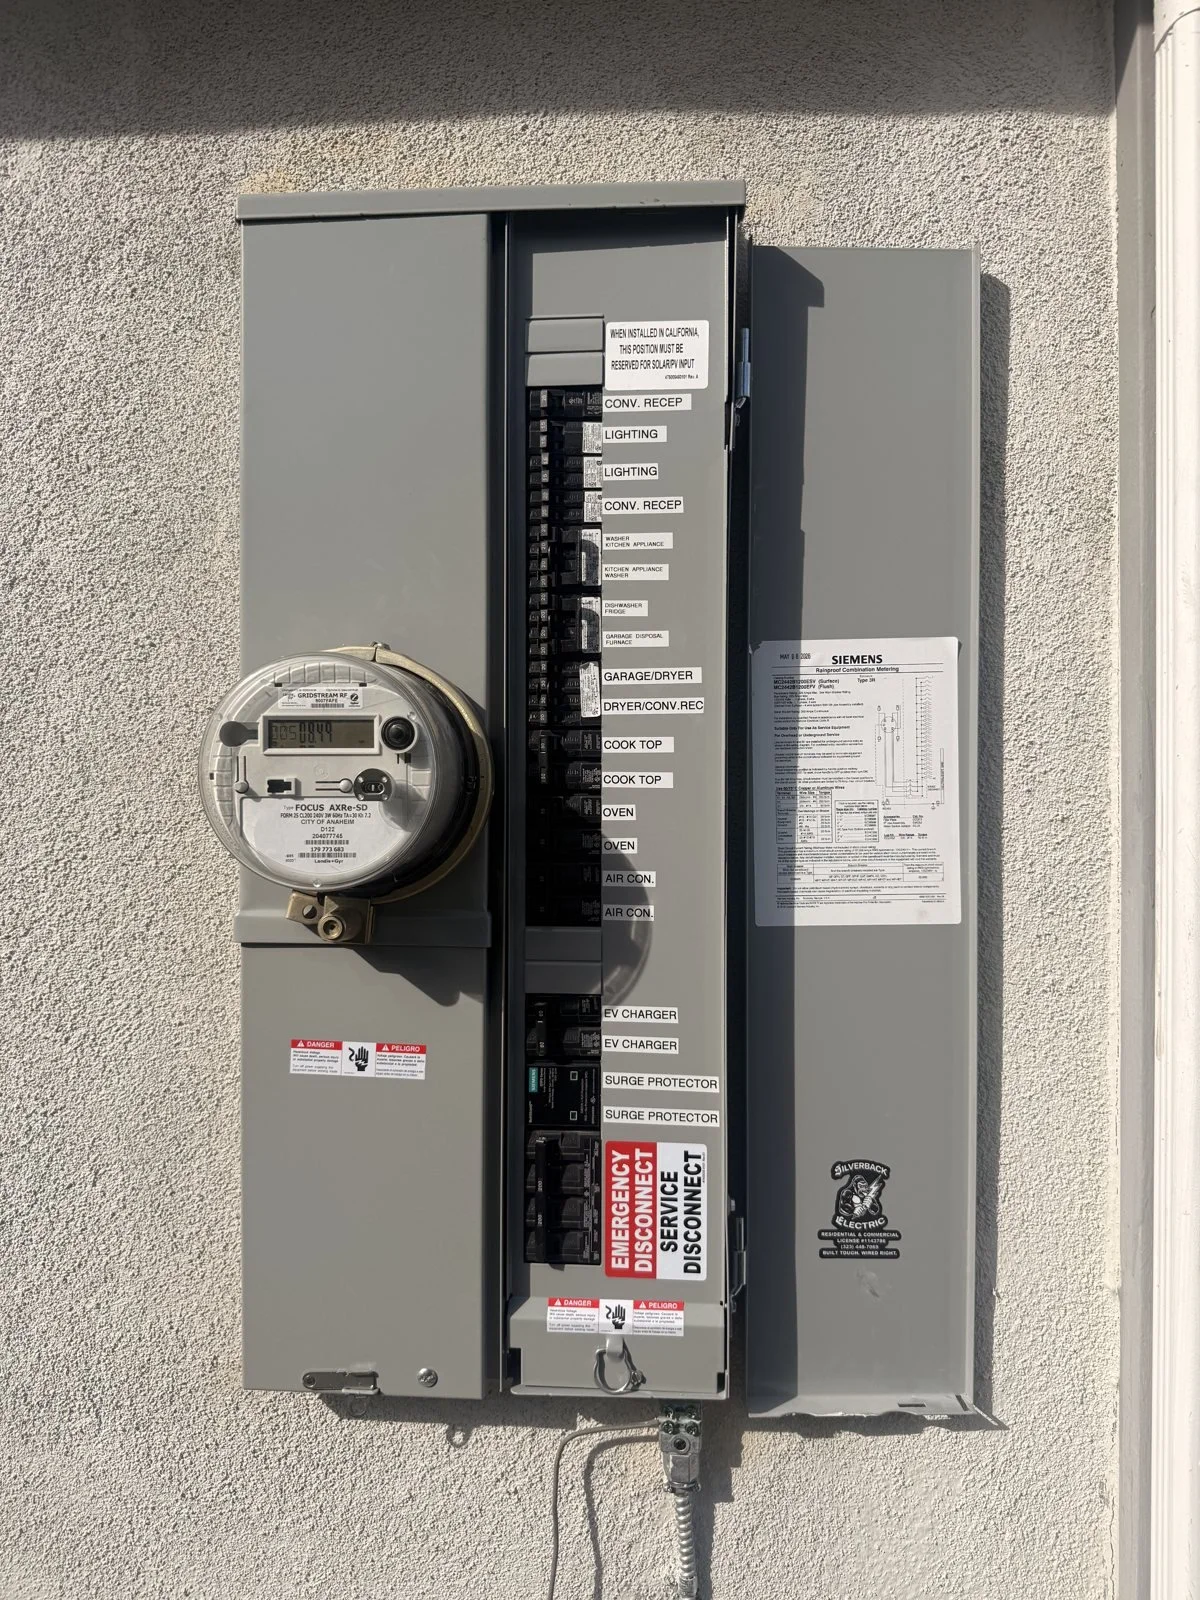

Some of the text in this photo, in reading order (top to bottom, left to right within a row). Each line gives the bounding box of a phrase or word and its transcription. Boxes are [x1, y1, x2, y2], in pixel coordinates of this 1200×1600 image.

[610, 328, 700, 338] WHEN INSTALLED IN CALIFORNIA,
[620, 344, 684, 354] THIS POSITION MUST BE
[611, 359, 695, 370] RESERVED FOR SOLAR/PV INPUT
[605, 398, 683, 408] CONV. RECEP
[605, 429, 658, 439] LIGHTING
[604, 466, 657, 477] LIGHTING
[604, 500, 681, 510] CONV. RECEP
[832, 655, 883, 664] SIEMENS
[604, 671, 692, 681] GARAGE/DRYER
[603, 701, 704, 711] DRYER/CONV.REC
[604, 740, 662, 749] COOK TOP
[603, 775, 661, 784] COOK TOP
[603, 808, 634, 817] OVEN
[604, 841, 634, 850] OVEN
[606, 874, 654, 883] AIR CON.
[605, 908, 654, 917] AIR CON.
[604, 1009, 677, 1020] EV CHARGER
[604, 1039, 677, 1050] EV CHARGER
[605, 1075, 718, 1089] SURGE PROTECTOR
[606, 1110, 718, 1123] SURGE PROTECTOR
[834, 1162, 888, 1176] SILVERBACK
[611, 1150, 630, 1269] EMERGENCY
[634, 1148, 653, 1272] DISCONNECT
[660, 1171, 678, 1252] SERVICE
[684, 1150, 702, 1274] DISCONNECT
[835, 1216, 885, 1230] ELECTRIC
